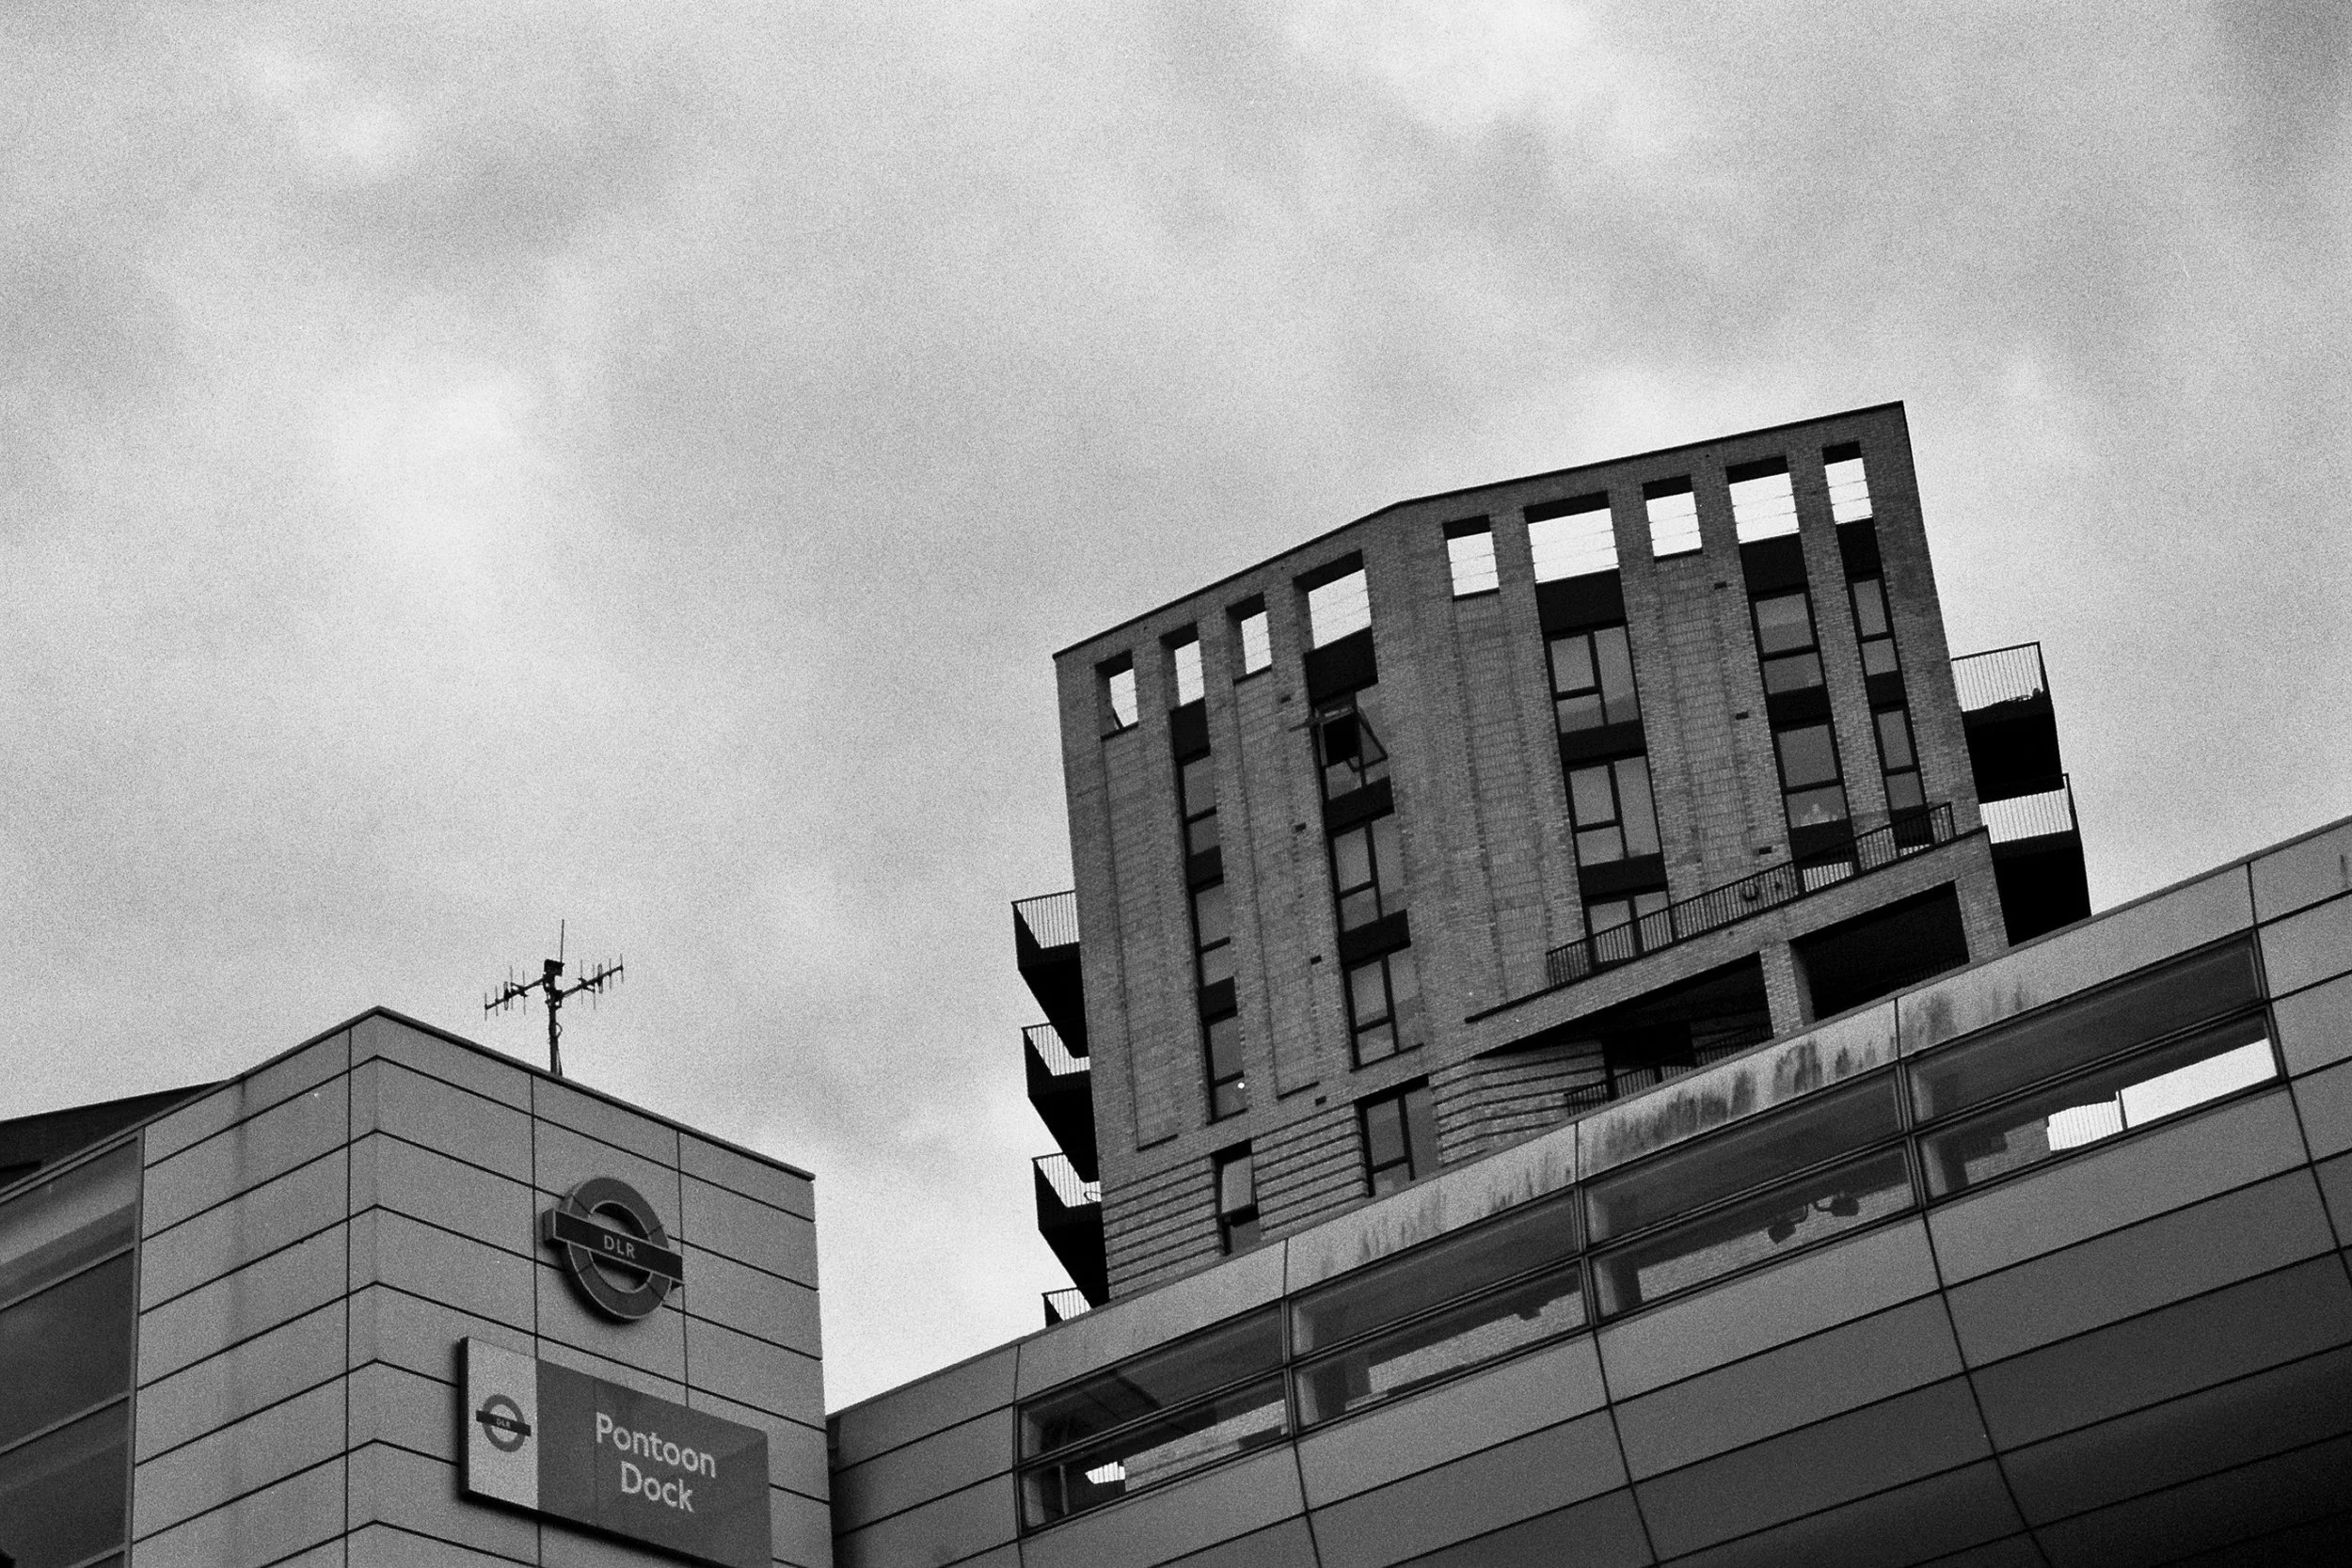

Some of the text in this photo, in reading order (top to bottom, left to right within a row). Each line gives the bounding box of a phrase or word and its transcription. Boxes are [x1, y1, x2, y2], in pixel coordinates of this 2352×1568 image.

[603, 1233, 636, 1259] DLR
[596, 1412, 717, 1479] Pontoon
[620, 1461, 695, 1513] Dock
